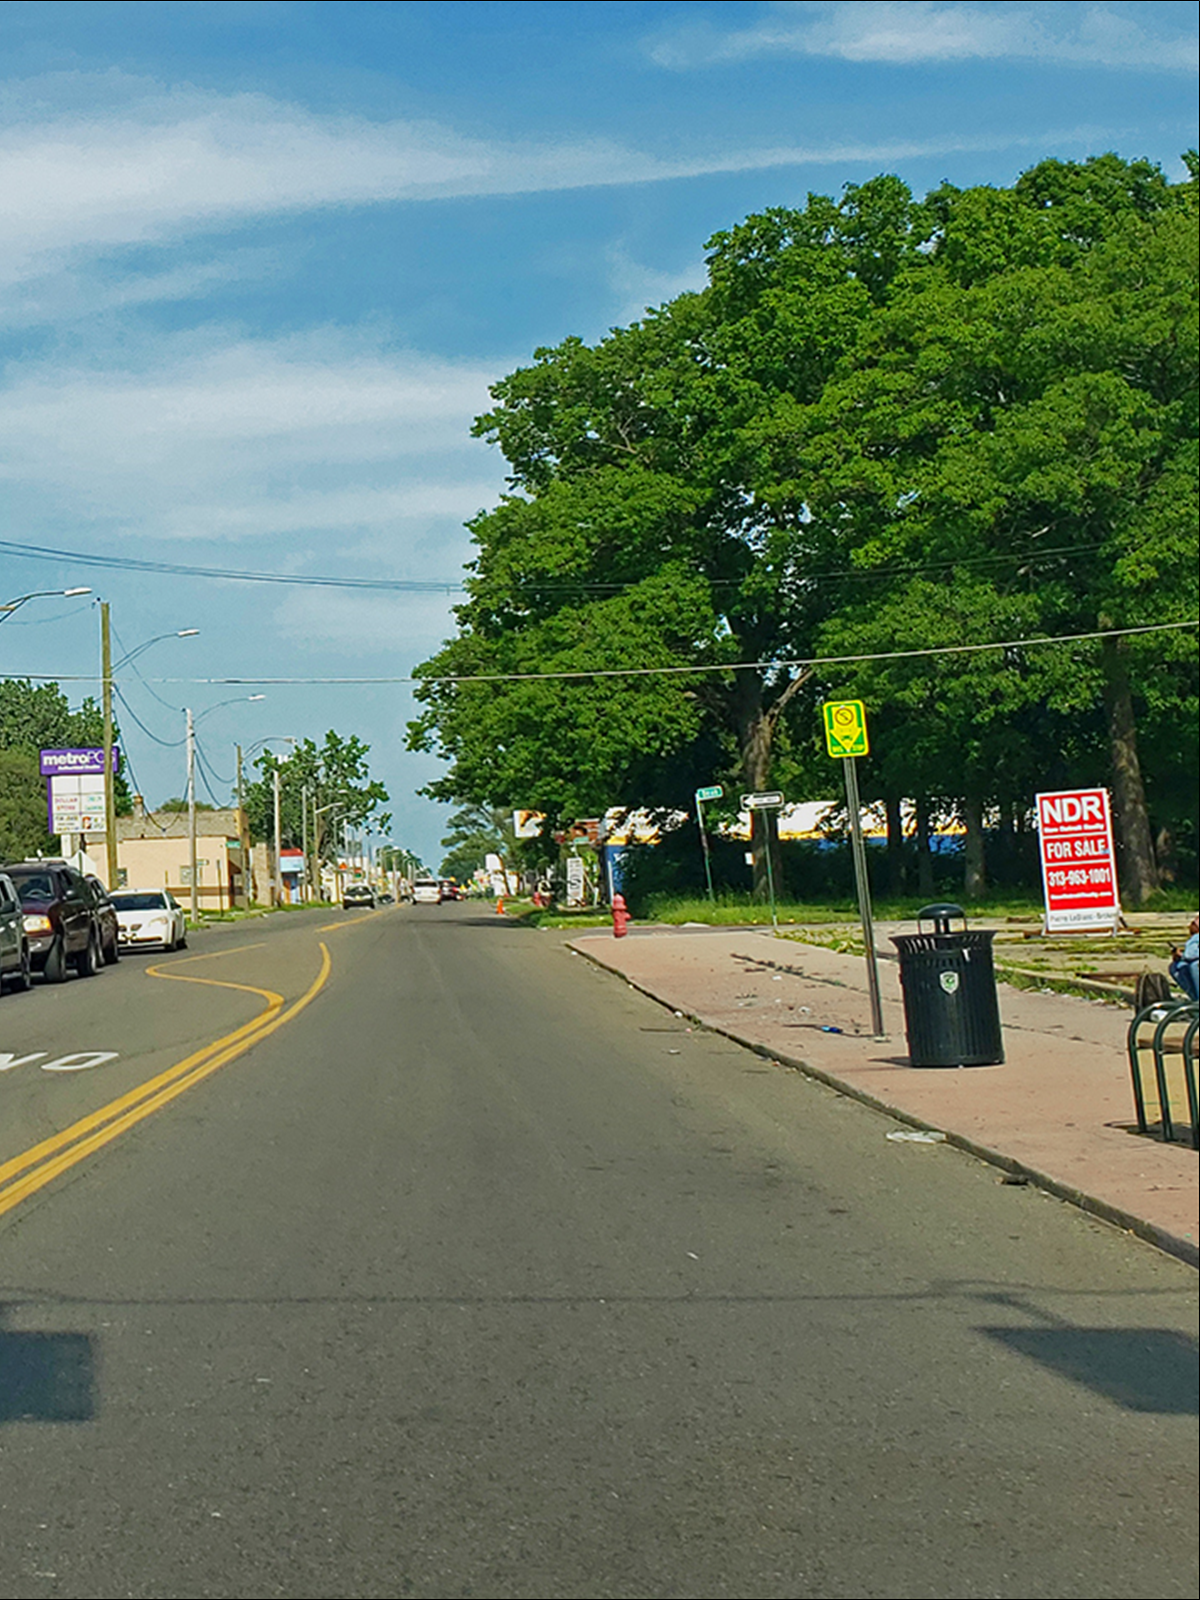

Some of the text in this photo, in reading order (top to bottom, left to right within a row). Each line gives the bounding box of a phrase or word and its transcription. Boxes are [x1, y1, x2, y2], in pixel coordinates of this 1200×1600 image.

[1042, 795, 1104, 824] NDR
[1046, 838, 1106, 860] FOR SALE
[1048, 867, 1112, 887] 313-963-1001
